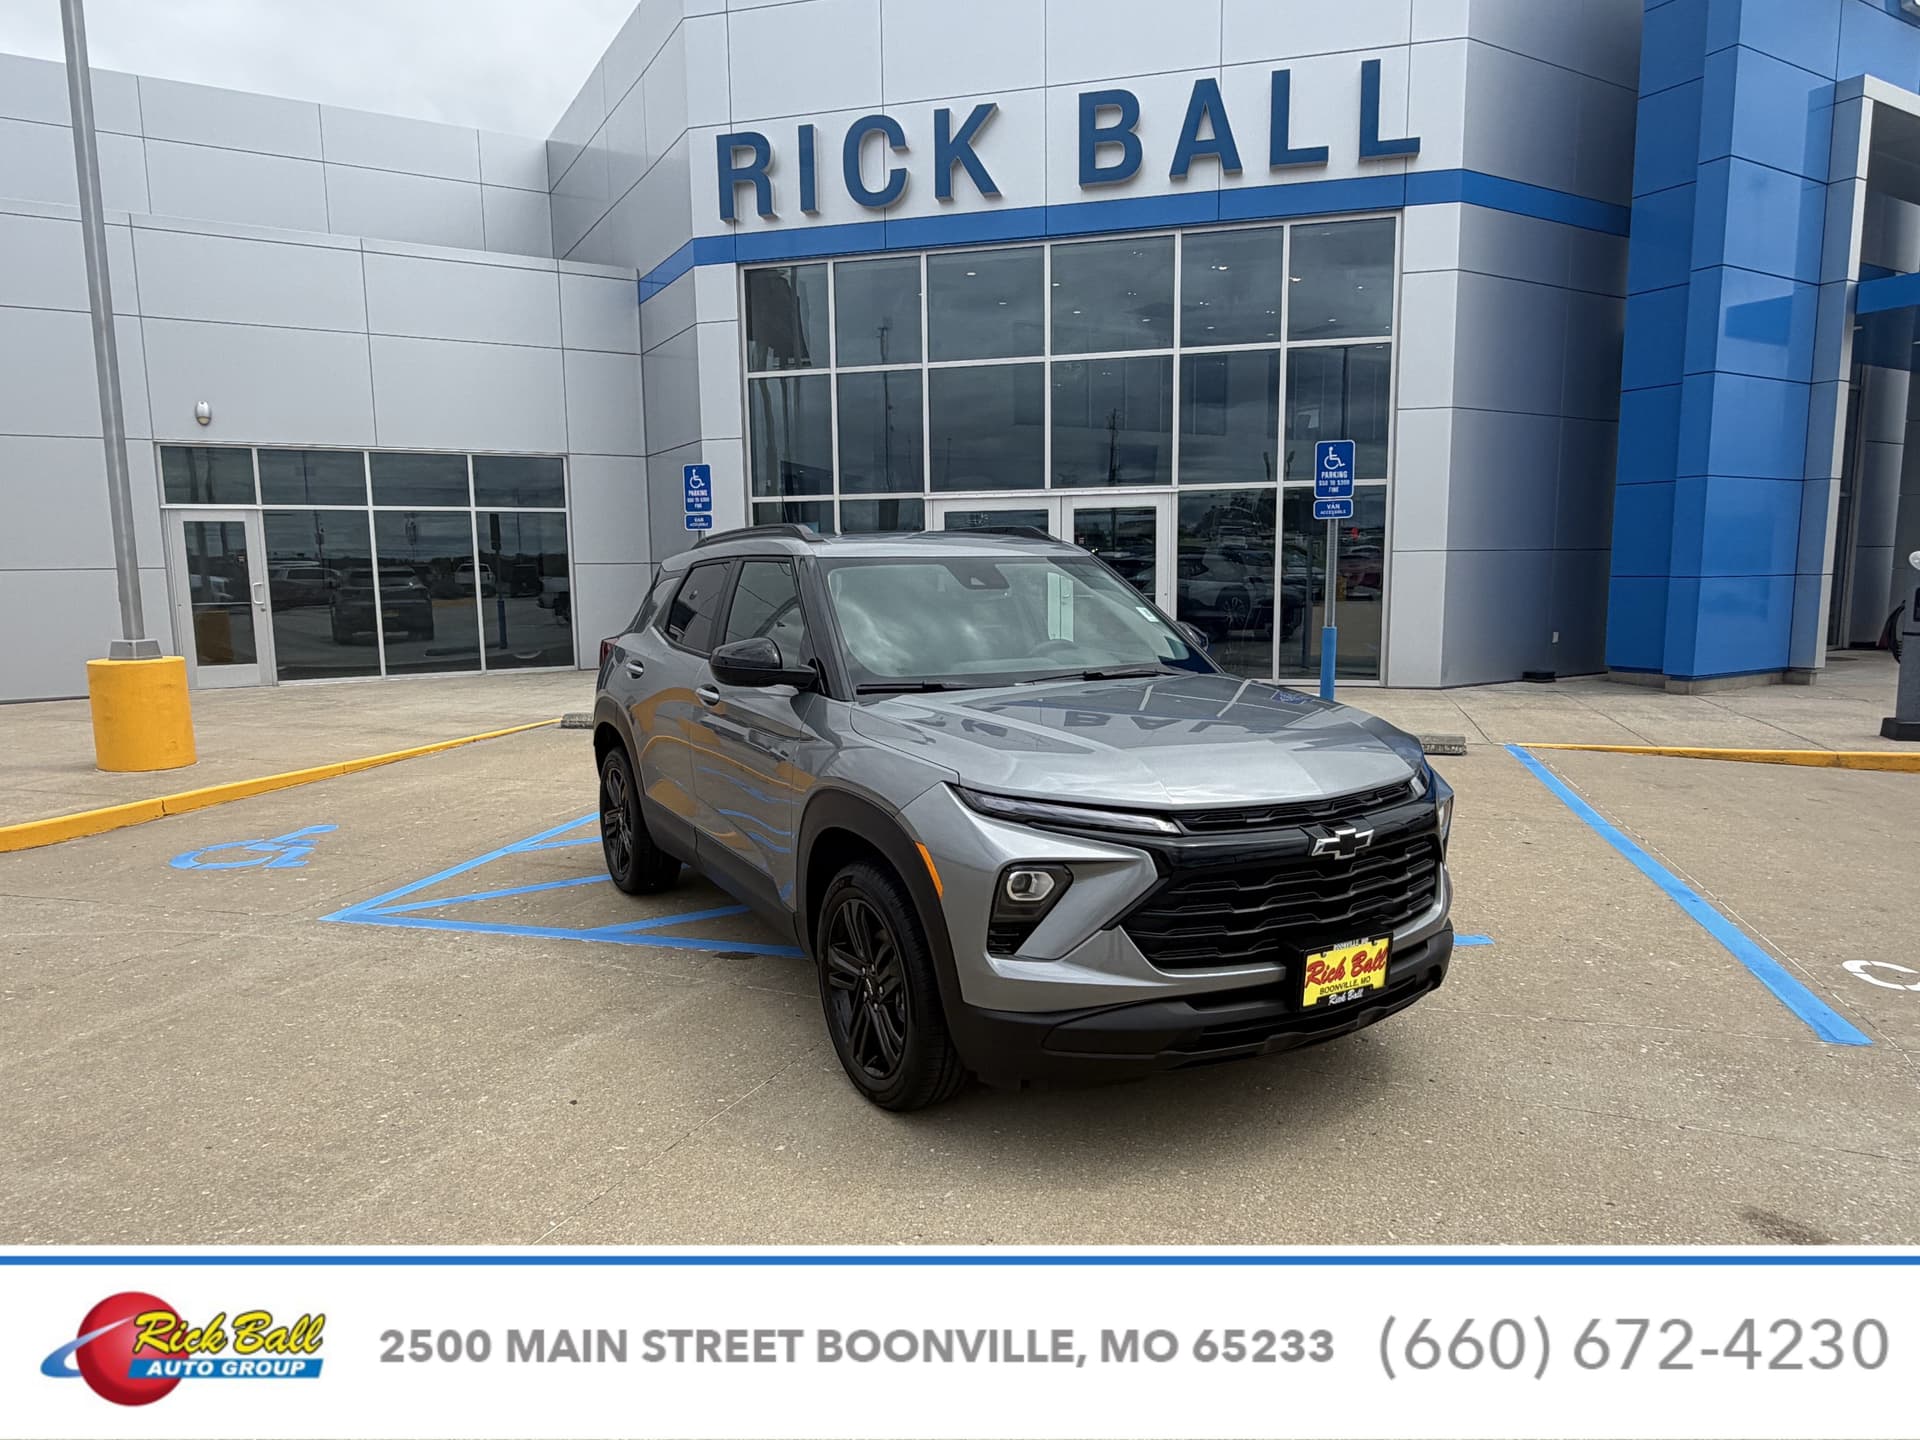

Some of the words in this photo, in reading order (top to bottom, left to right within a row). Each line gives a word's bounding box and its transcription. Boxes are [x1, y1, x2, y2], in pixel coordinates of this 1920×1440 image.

[715, 102, 1001, 223] RICK
[1079, 58, 1421, 191] BALL
[1321, 471, 1348, 479] PARKING
[1305, 956, 1346, 988] Rick
[1351, 948, 1388, 977] Ball
[1360, 976, 1371, 985] MO
[1328, 993, 1346, 1005] Rick
[1347, 988, 1364, 1000] Ball
